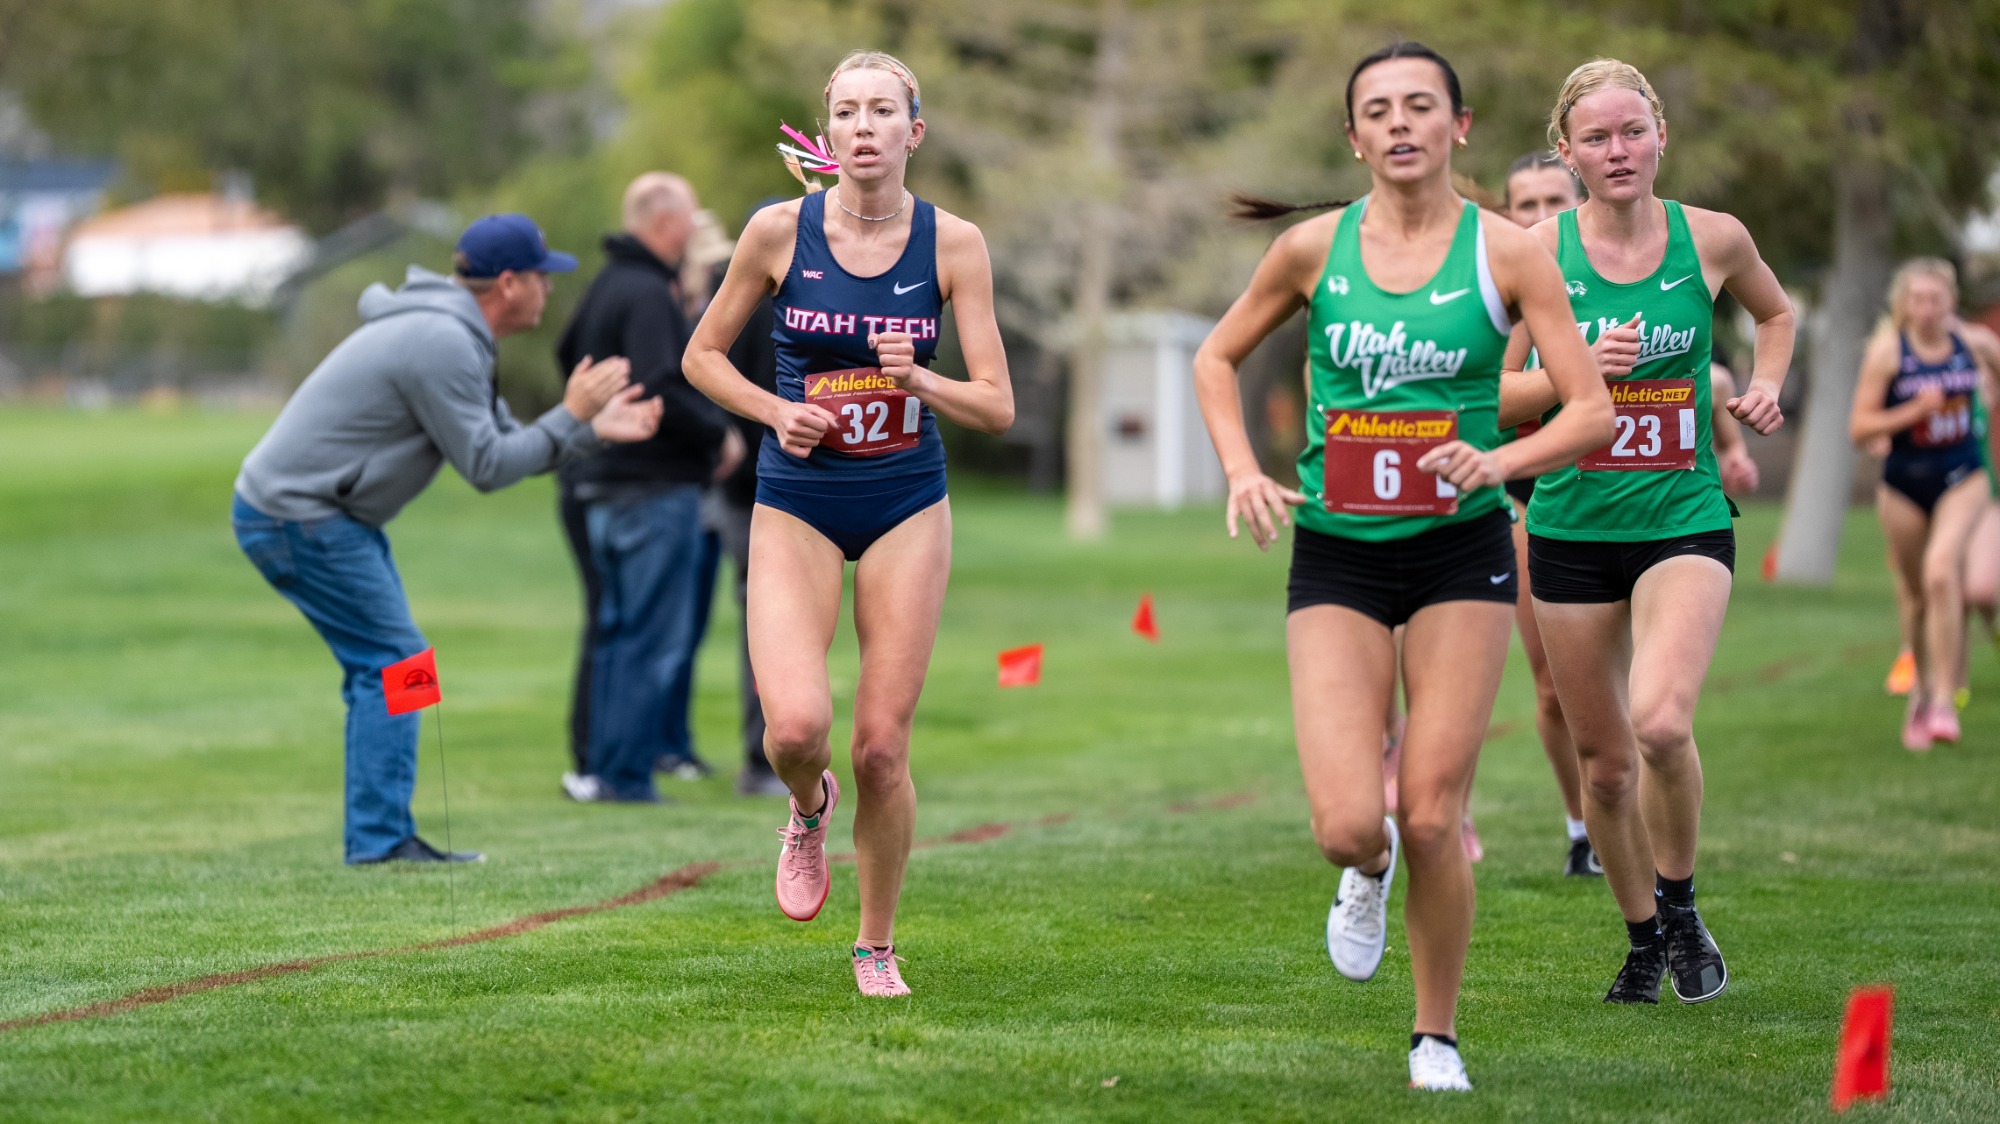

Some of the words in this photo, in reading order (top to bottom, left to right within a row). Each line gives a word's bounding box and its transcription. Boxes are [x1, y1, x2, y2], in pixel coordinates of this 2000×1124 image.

[802, 269, 824, 280] WAC
[785, 306, 857, 336] UTAH
[861, 314, 936, 340] TECH
[1325, 320, 1409, 368] Utah
[1631, 324, 1696, 368] alley
[808, 373, 889, 396] Athletic
[1351, 340, 1469, 399] Valley
[1608, 385, 1662, 403] hletic
[841, 401, 889, 444] 32
[1328, 413, 1417, 437] Athletic
[1611, 414, 1662, 457] 23
[1373, 449, 1401, 500] 6
